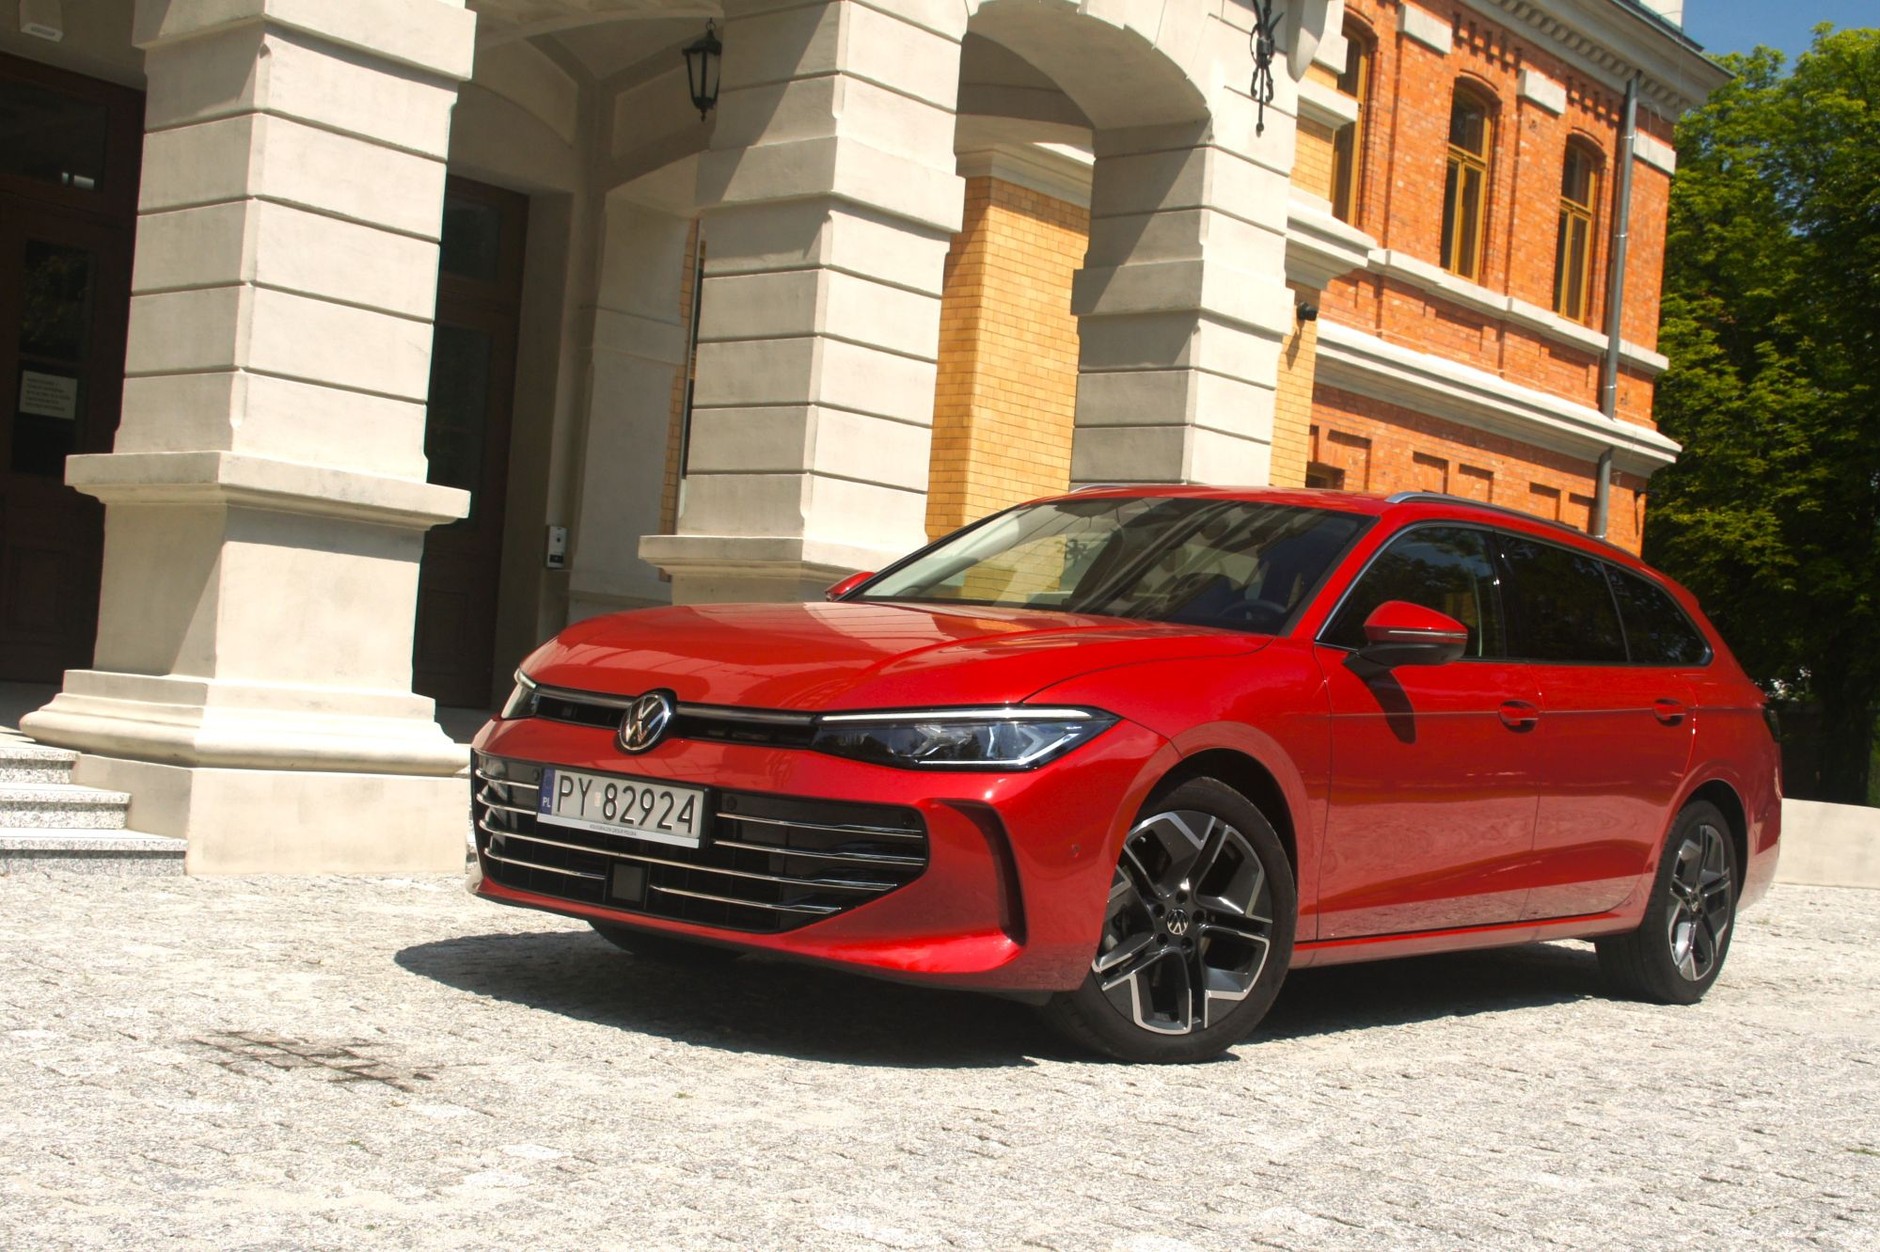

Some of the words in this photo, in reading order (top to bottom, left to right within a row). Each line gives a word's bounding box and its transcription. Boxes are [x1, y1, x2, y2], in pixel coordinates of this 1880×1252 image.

[621, 695, 669, 749] VW
[542, 797, 551, 808] PL
[557, 775, 593, 817] PY
[602, 782, 696, 834] 82924
